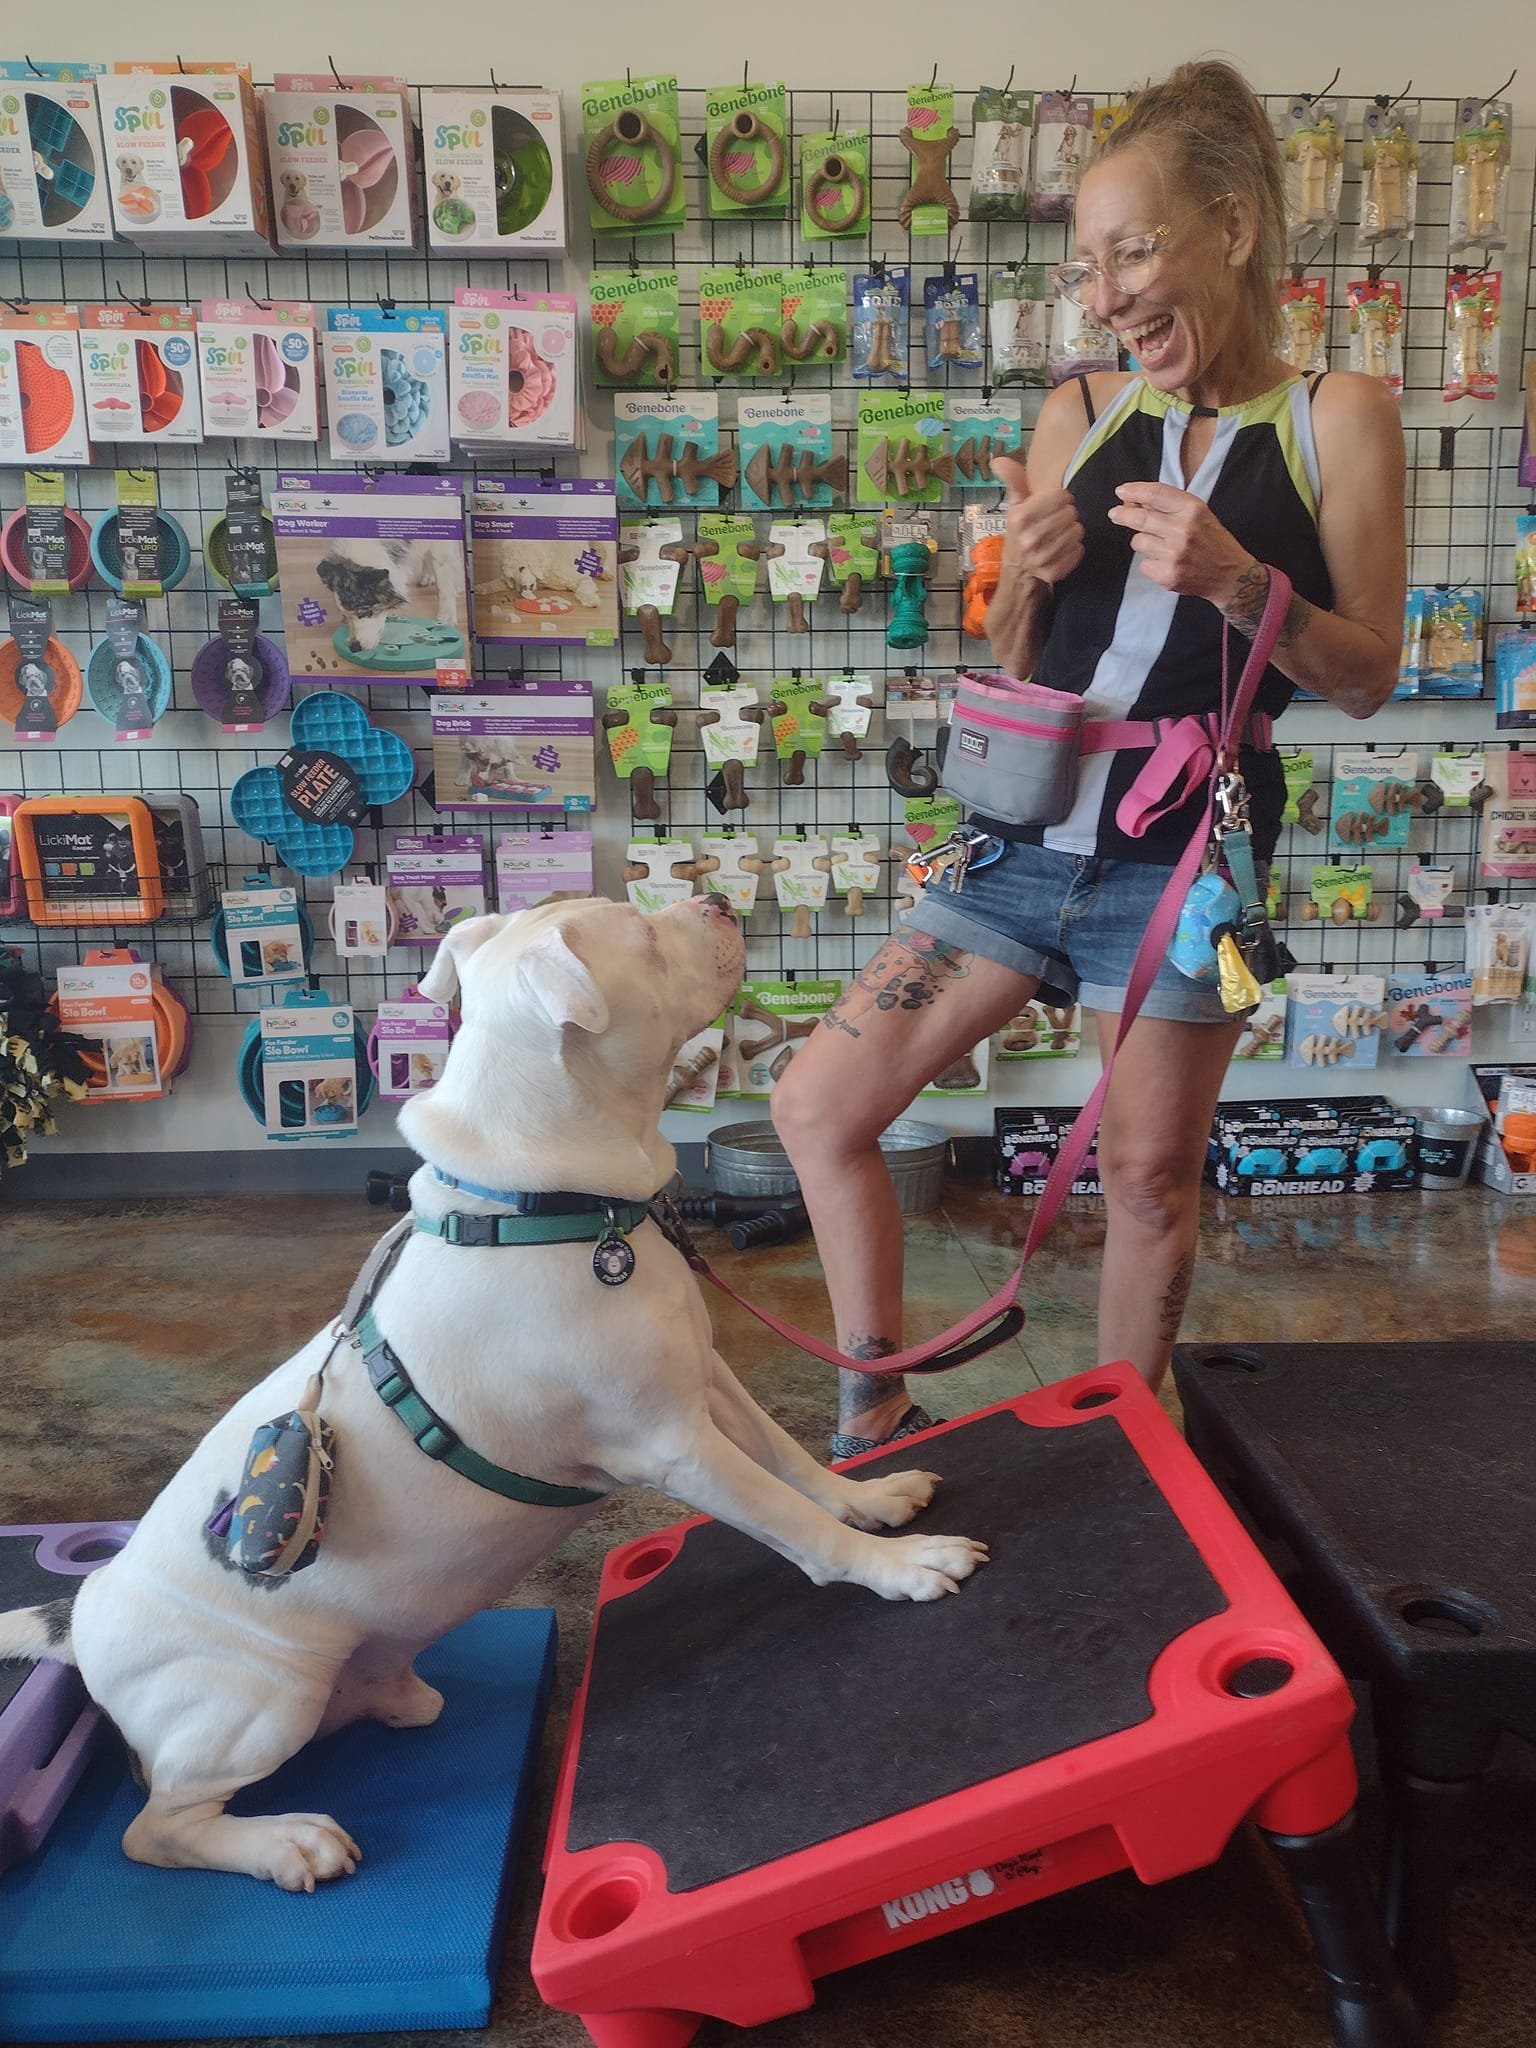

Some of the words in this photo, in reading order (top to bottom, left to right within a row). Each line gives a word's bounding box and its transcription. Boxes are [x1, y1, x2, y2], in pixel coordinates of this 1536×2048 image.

[582, 78, 678, 118] Benebone
[706, 83, 786, 118] Benebone
[907, 92, 953, 107] Benebone
[114, 105, 165, 133] Spin
[277, 122, 328, 149] Spin
[434, 125, 483, 150] Spin
[803, 135, 868, 163] Benebone
[590, 274, 678, 301] Benebone
[700, 272, 782, 298] Benebone
[462, 293, 490, 306] Spin
[216, 303, 242, 316] Spin
[98, 310, 125, 323] Spin
[334, 314, 361, 327] Spin
[459, 333, 503, 355] Spin
[89, 352, 128, 371] Spin
[206, 347, 245, 366] Spin
[333, 357, 376, 378] Spin
[626, 403, 685, 415] Benebone
[745, 407, 804, 420] Benebone
[859, 399, 945, 425] Benebone
[954, 404, 1000, 416] Benebone
[278, 519, 295, 528] Dog
[297, 519, 328, 528] Worker
[474, 520, 490, 529] Dog
[491, 521, 514, 529] Smart
[700, 523, 753, 536] Benebone
[830, 520, 877, 533] Benebone
[27, 535, 65, 544] LickiMat
[119, 535, 158, 544] LickiMat
[227, 541, 265, 552] LickiMat
[16, 611, 47, 620] LickiMat
[110, 608, 138, 618] LickiMat
[223, 609, 254, 618] LickiMat
[772, 682, 823, 699] Benebone
[436, 720, 451, 728] Dog
[451, 719, 471, 727] Brick
[1283, 759, 1313, 774] bone
[1340, 764, 1393, 776] Benebone
[290, 780, 308, 798] SLOW
[304, 758, 326, 782] FEEDER
[297, 764, 340, 809] PLATE
[905, 803, 959, 823] Benebone
[40, 834, 94, 846] LickiMat
[1312, 871, 1372, 889] Benebone
[227, 915, 240, 924] Slo
[242, 914, 264, 923] Bowl
[1302, 989, 1358, 1000] Benebone
[1388, 977, 1472, 1001] Benebone
[756, 991, 836, 1006] Benebone
[63, 1008, 79, 1018] Slo
[81, 1007, 106, 1017] Bowl
[266, 1018, 296, 1028] hound
[397, 1026, 416, 1034] Bowl
[265, 1046, 281, 1055] Slo
[283, 1045, 309, 1055] Bowl
[1360, 1126, 1415, 1137] ONEHEAD
[881, 1876, 969, 1929] KONG
